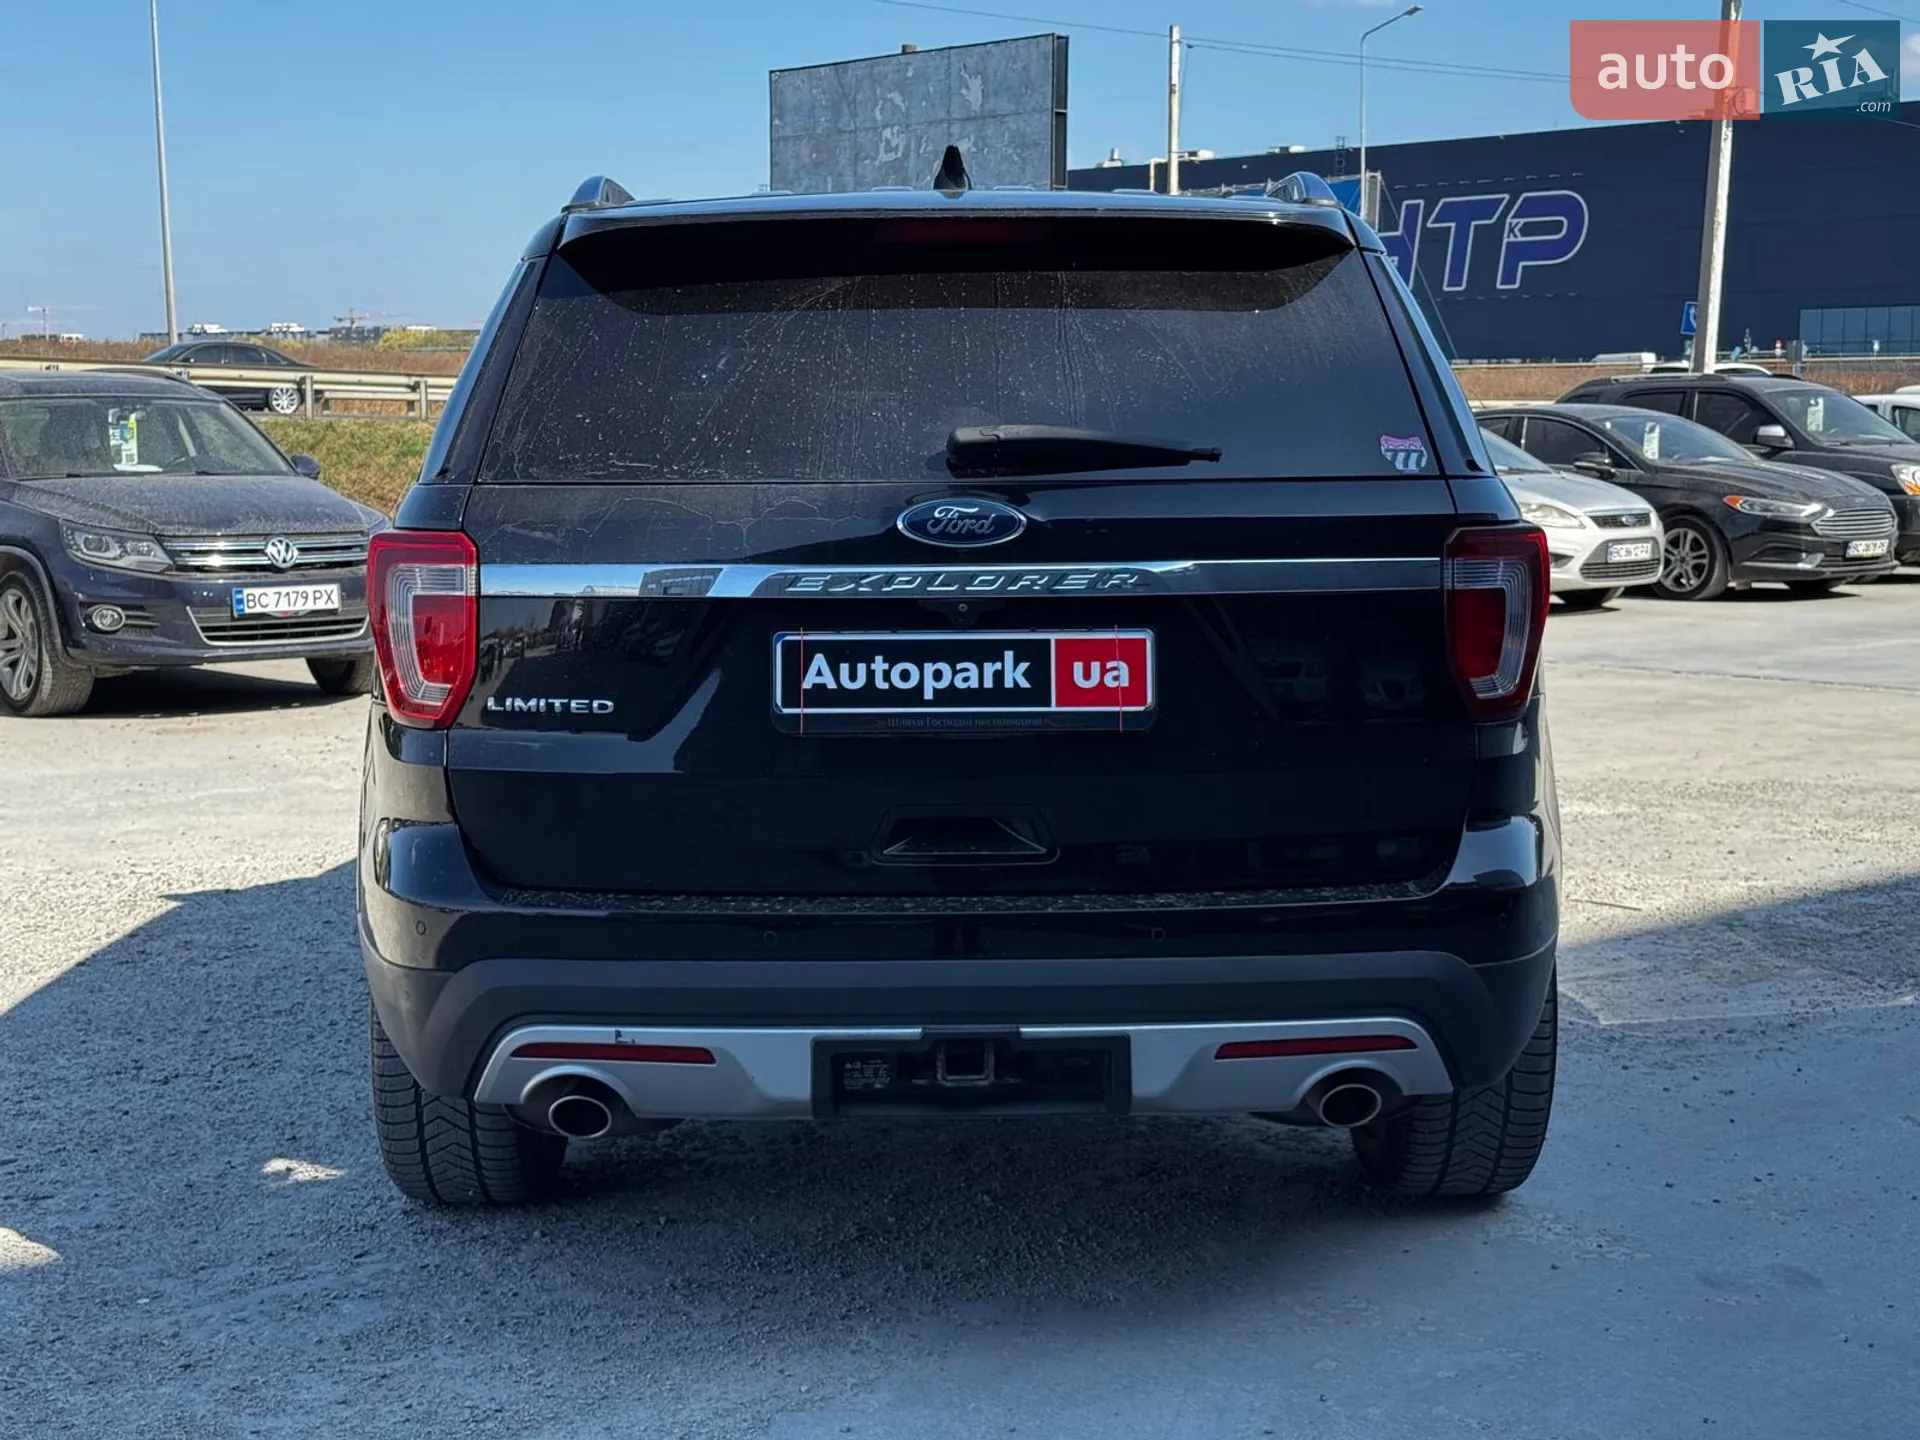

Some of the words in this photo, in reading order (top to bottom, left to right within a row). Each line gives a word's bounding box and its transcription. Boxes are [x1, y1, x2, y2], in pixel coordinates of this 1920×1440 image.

[926, 505, 996, 536] Ford
[785, 572, 1139, 592] EXPLORER
[245, 592, 269, 609] BC
[273, 590, 309, 607] 7179
[312, 588, 335, 606] PX
[802, 650, 1032, 700] Autopark
[1072, 660, 1130, 688] ua
[487, 696, 615, 714] LIMITED
